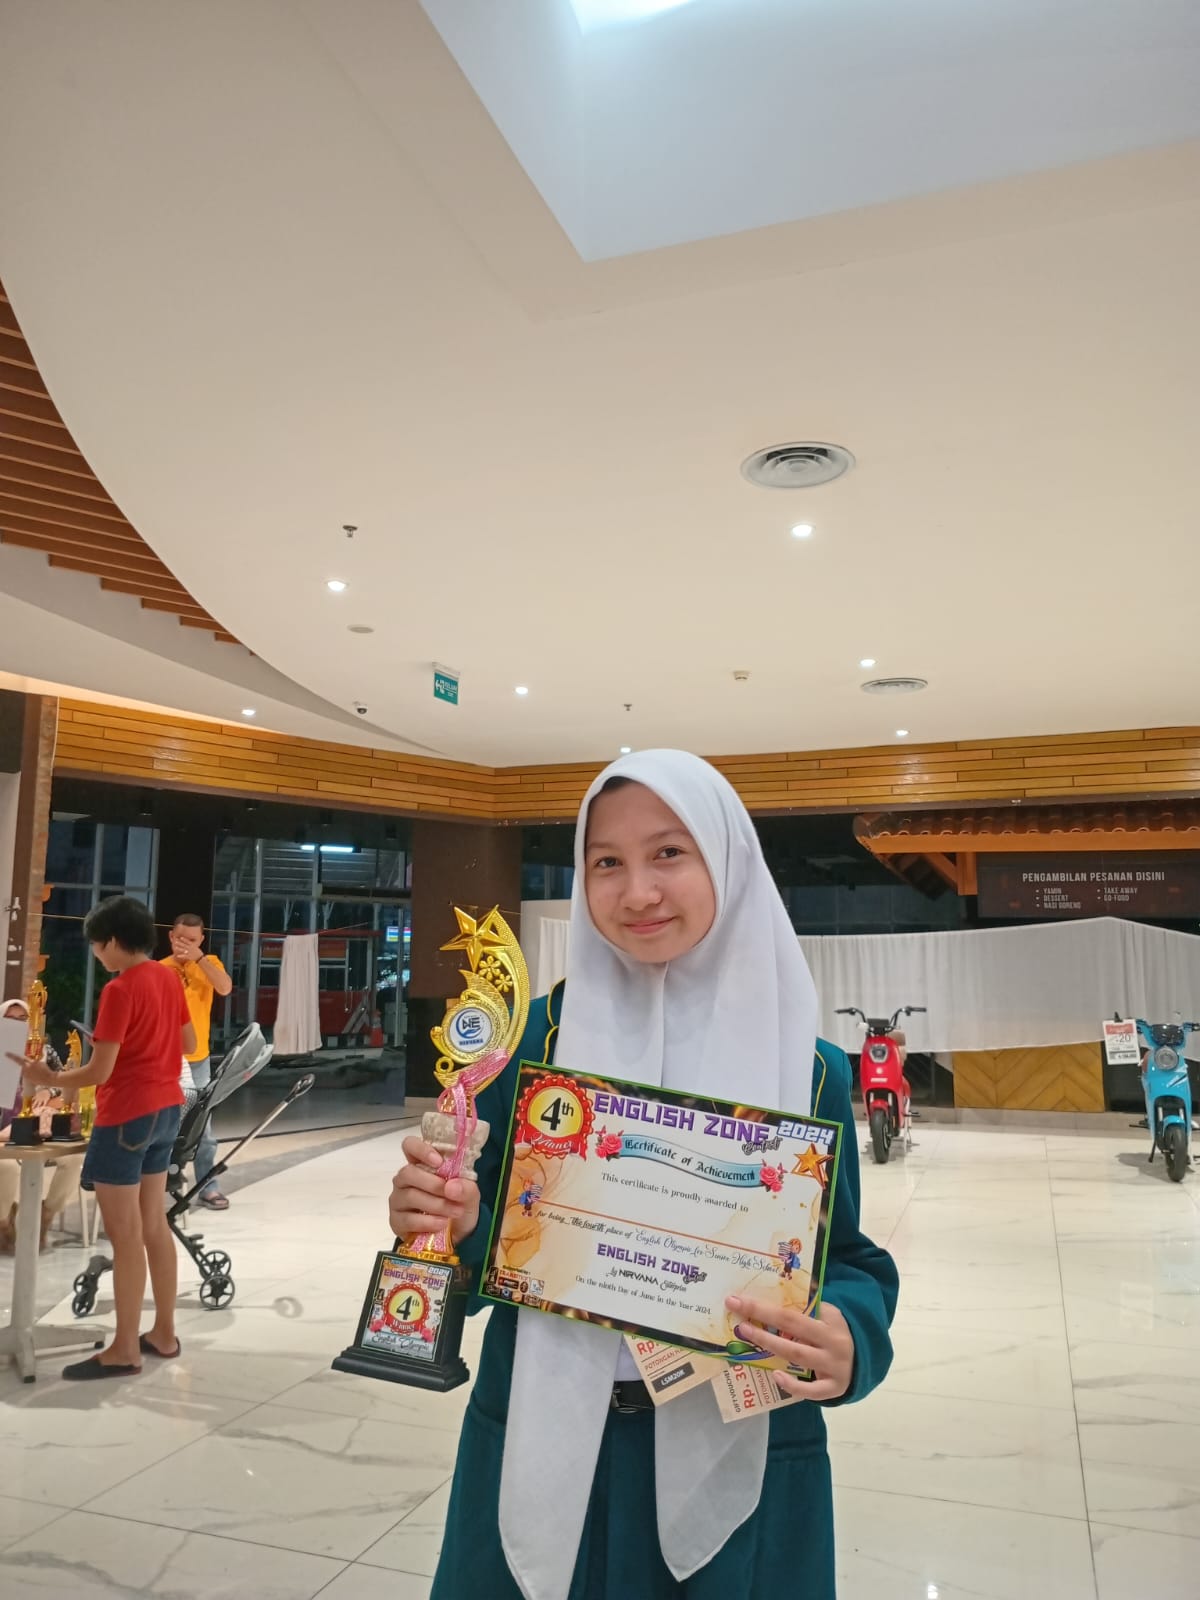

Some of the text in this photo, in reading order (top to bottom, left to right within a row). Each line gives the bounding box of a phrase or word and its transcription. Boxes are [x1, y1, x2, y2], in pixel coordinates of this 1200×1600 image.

[1022, 871, 1165, 882] PENGAMBILAN PESANAN DISINI
[540, 1096, 574, 1131] 4th
[594, 1092, 835, 1146] ENGLISH ZONE 2024
[625, 1139, 755, 1181] Certificate of Achievement
[600, 1172, 749, 1213] This certificate is proudly awarded to
[597, 1242, 700, 1278] ENGLISH ZONE
[605, 1226, 623, 1236] place
[636, 1228, 661, 1246] English
[732, 1253, 752, 1269] High
[752, 1256, 780, 1274] School
[384, 1269, 446, 1287] ENGLISH ZONE
[576, 1275, 584, 1284] On
[586, 1278, 596, 1286] the
[630, 1289, 638, 1297] of
[640, 1292, 656, 1301] June
[657, 1295, 664, 1303] in
[666, 1297, 677, 1306] the
[618, 1269, 658, 1286] NIRVANA
[644, 1350, 676, 1371] POTONGAN
[731, 1396, 741, 1413] GIFT
[743, 1384, 756, 1410] Rp.
